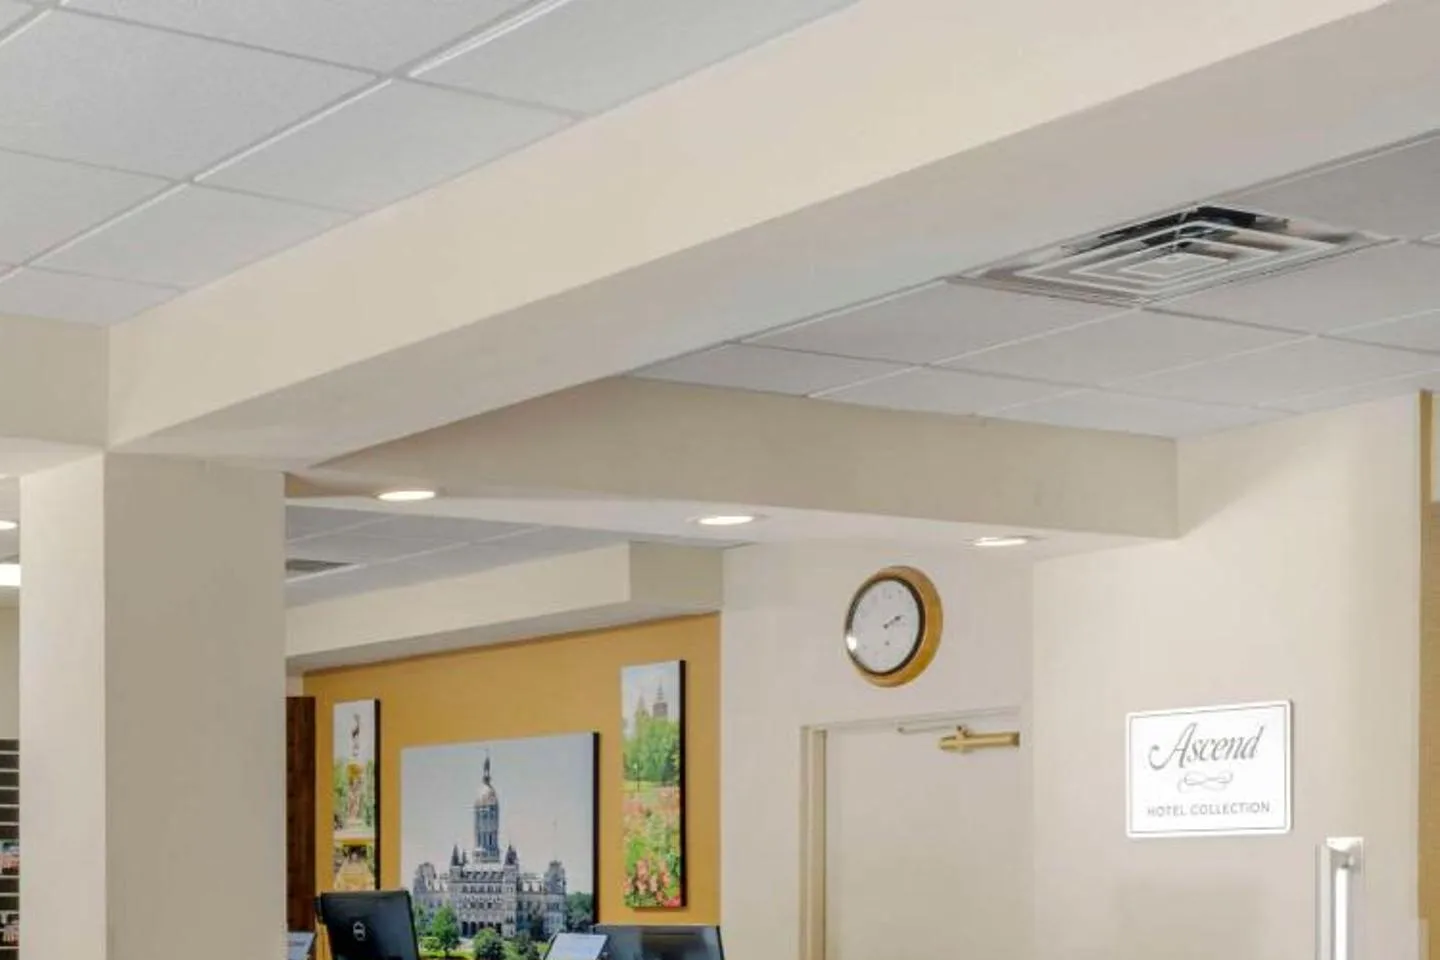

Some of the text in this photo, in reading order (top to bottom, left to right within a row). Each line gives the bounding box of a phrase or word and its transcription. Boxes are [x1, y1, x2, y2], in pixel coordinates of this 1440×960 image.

[1148, 721, 1266, 771] Ascend
[1147, 801, 1271, 818] HOTEL COLLECTION
